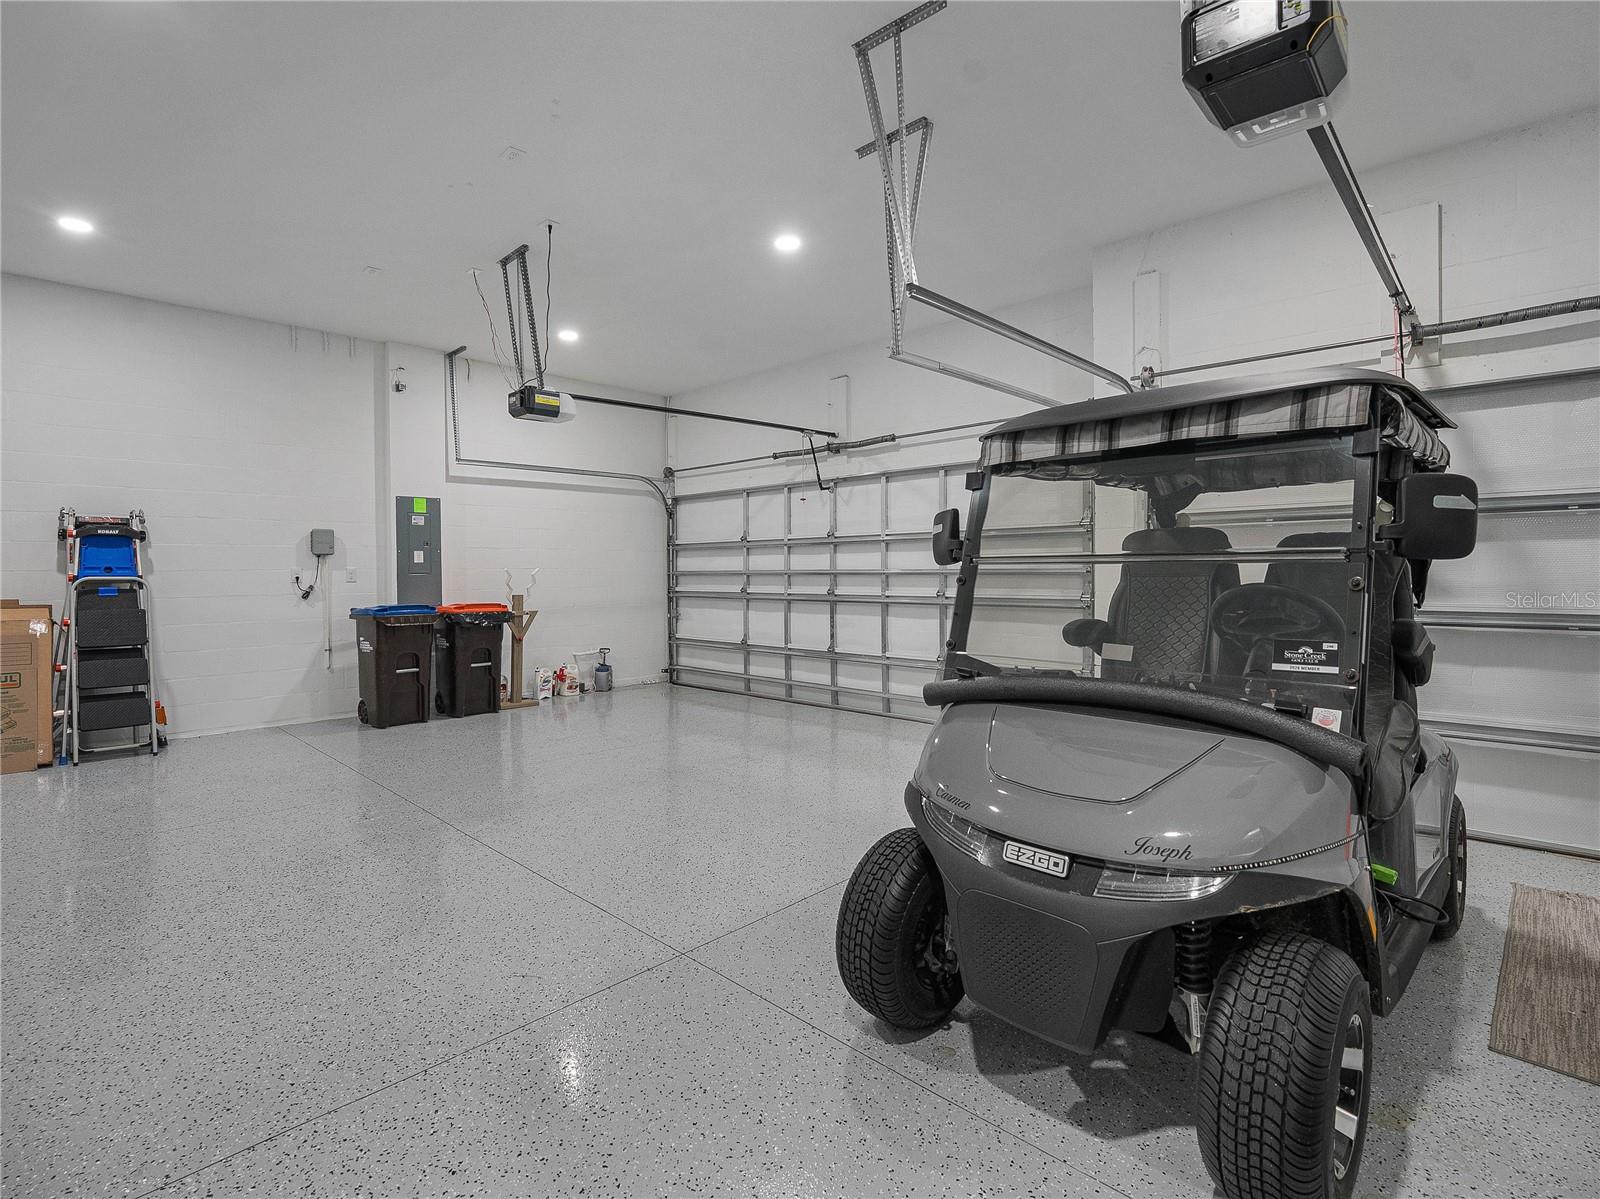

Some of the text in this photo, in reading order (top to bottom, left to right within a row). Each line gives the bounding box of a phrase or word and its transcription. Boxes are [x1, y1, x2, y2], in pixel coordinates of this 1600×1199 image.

[1284, 650, 1326, 660] Stone Creek
[1006, 844, 1065, 873] EZGO
[1124, 836, 1193, 863] Joseph
